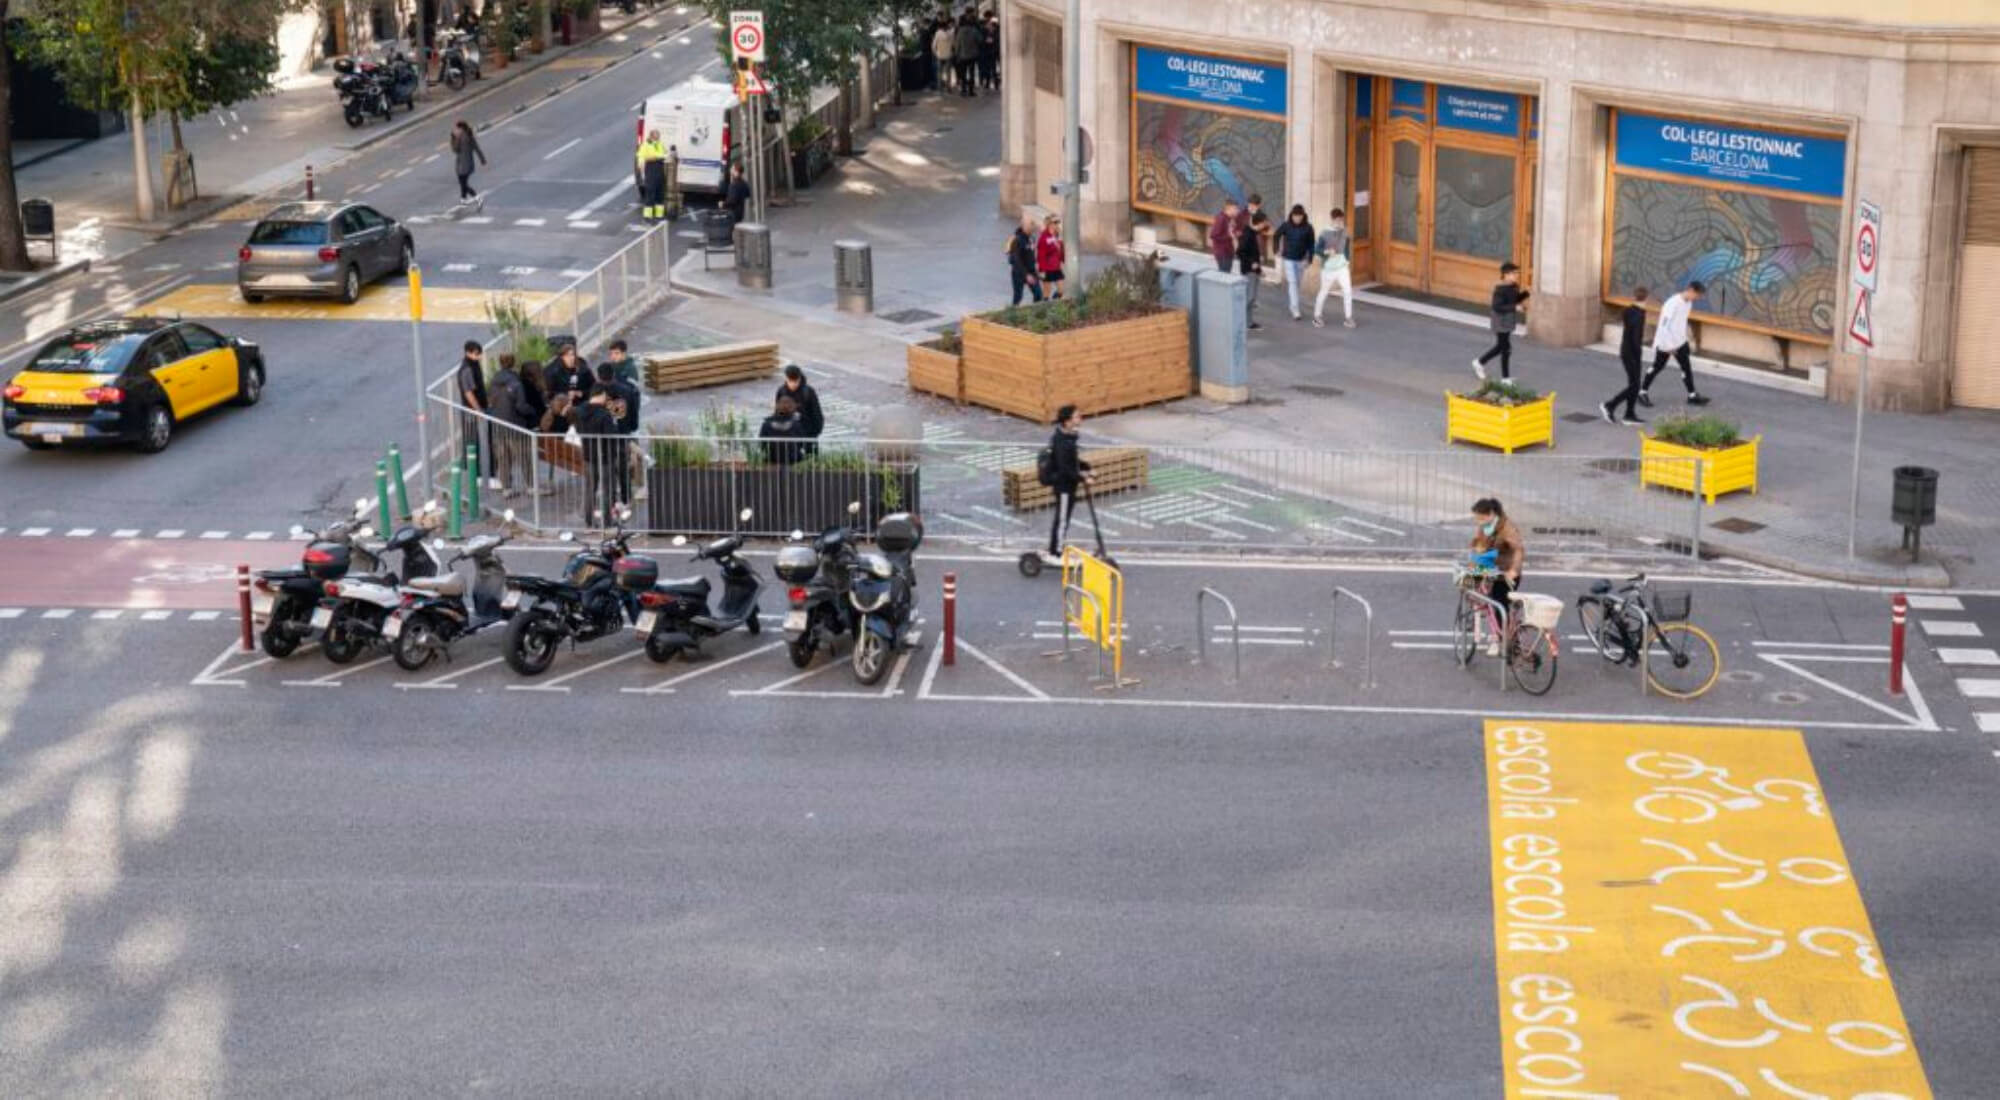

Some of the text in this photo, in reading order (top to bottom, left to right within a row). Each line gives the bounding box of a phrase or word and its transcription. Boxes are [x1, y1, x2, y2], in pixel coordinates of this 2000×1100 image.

[739, 33, 756, 44] 30
[1209, 62, 1265, 83] LESTONNAC
[1187, 73, 1243, 95] BARCELONA
[1722, 133, 1804, 158] LESTONNAC
[1690, 146, 1769, 171] BARCELONA
[1862, 239, 1872, 257] 30
[1494, 726, 1620, 1100] escola escola escol
